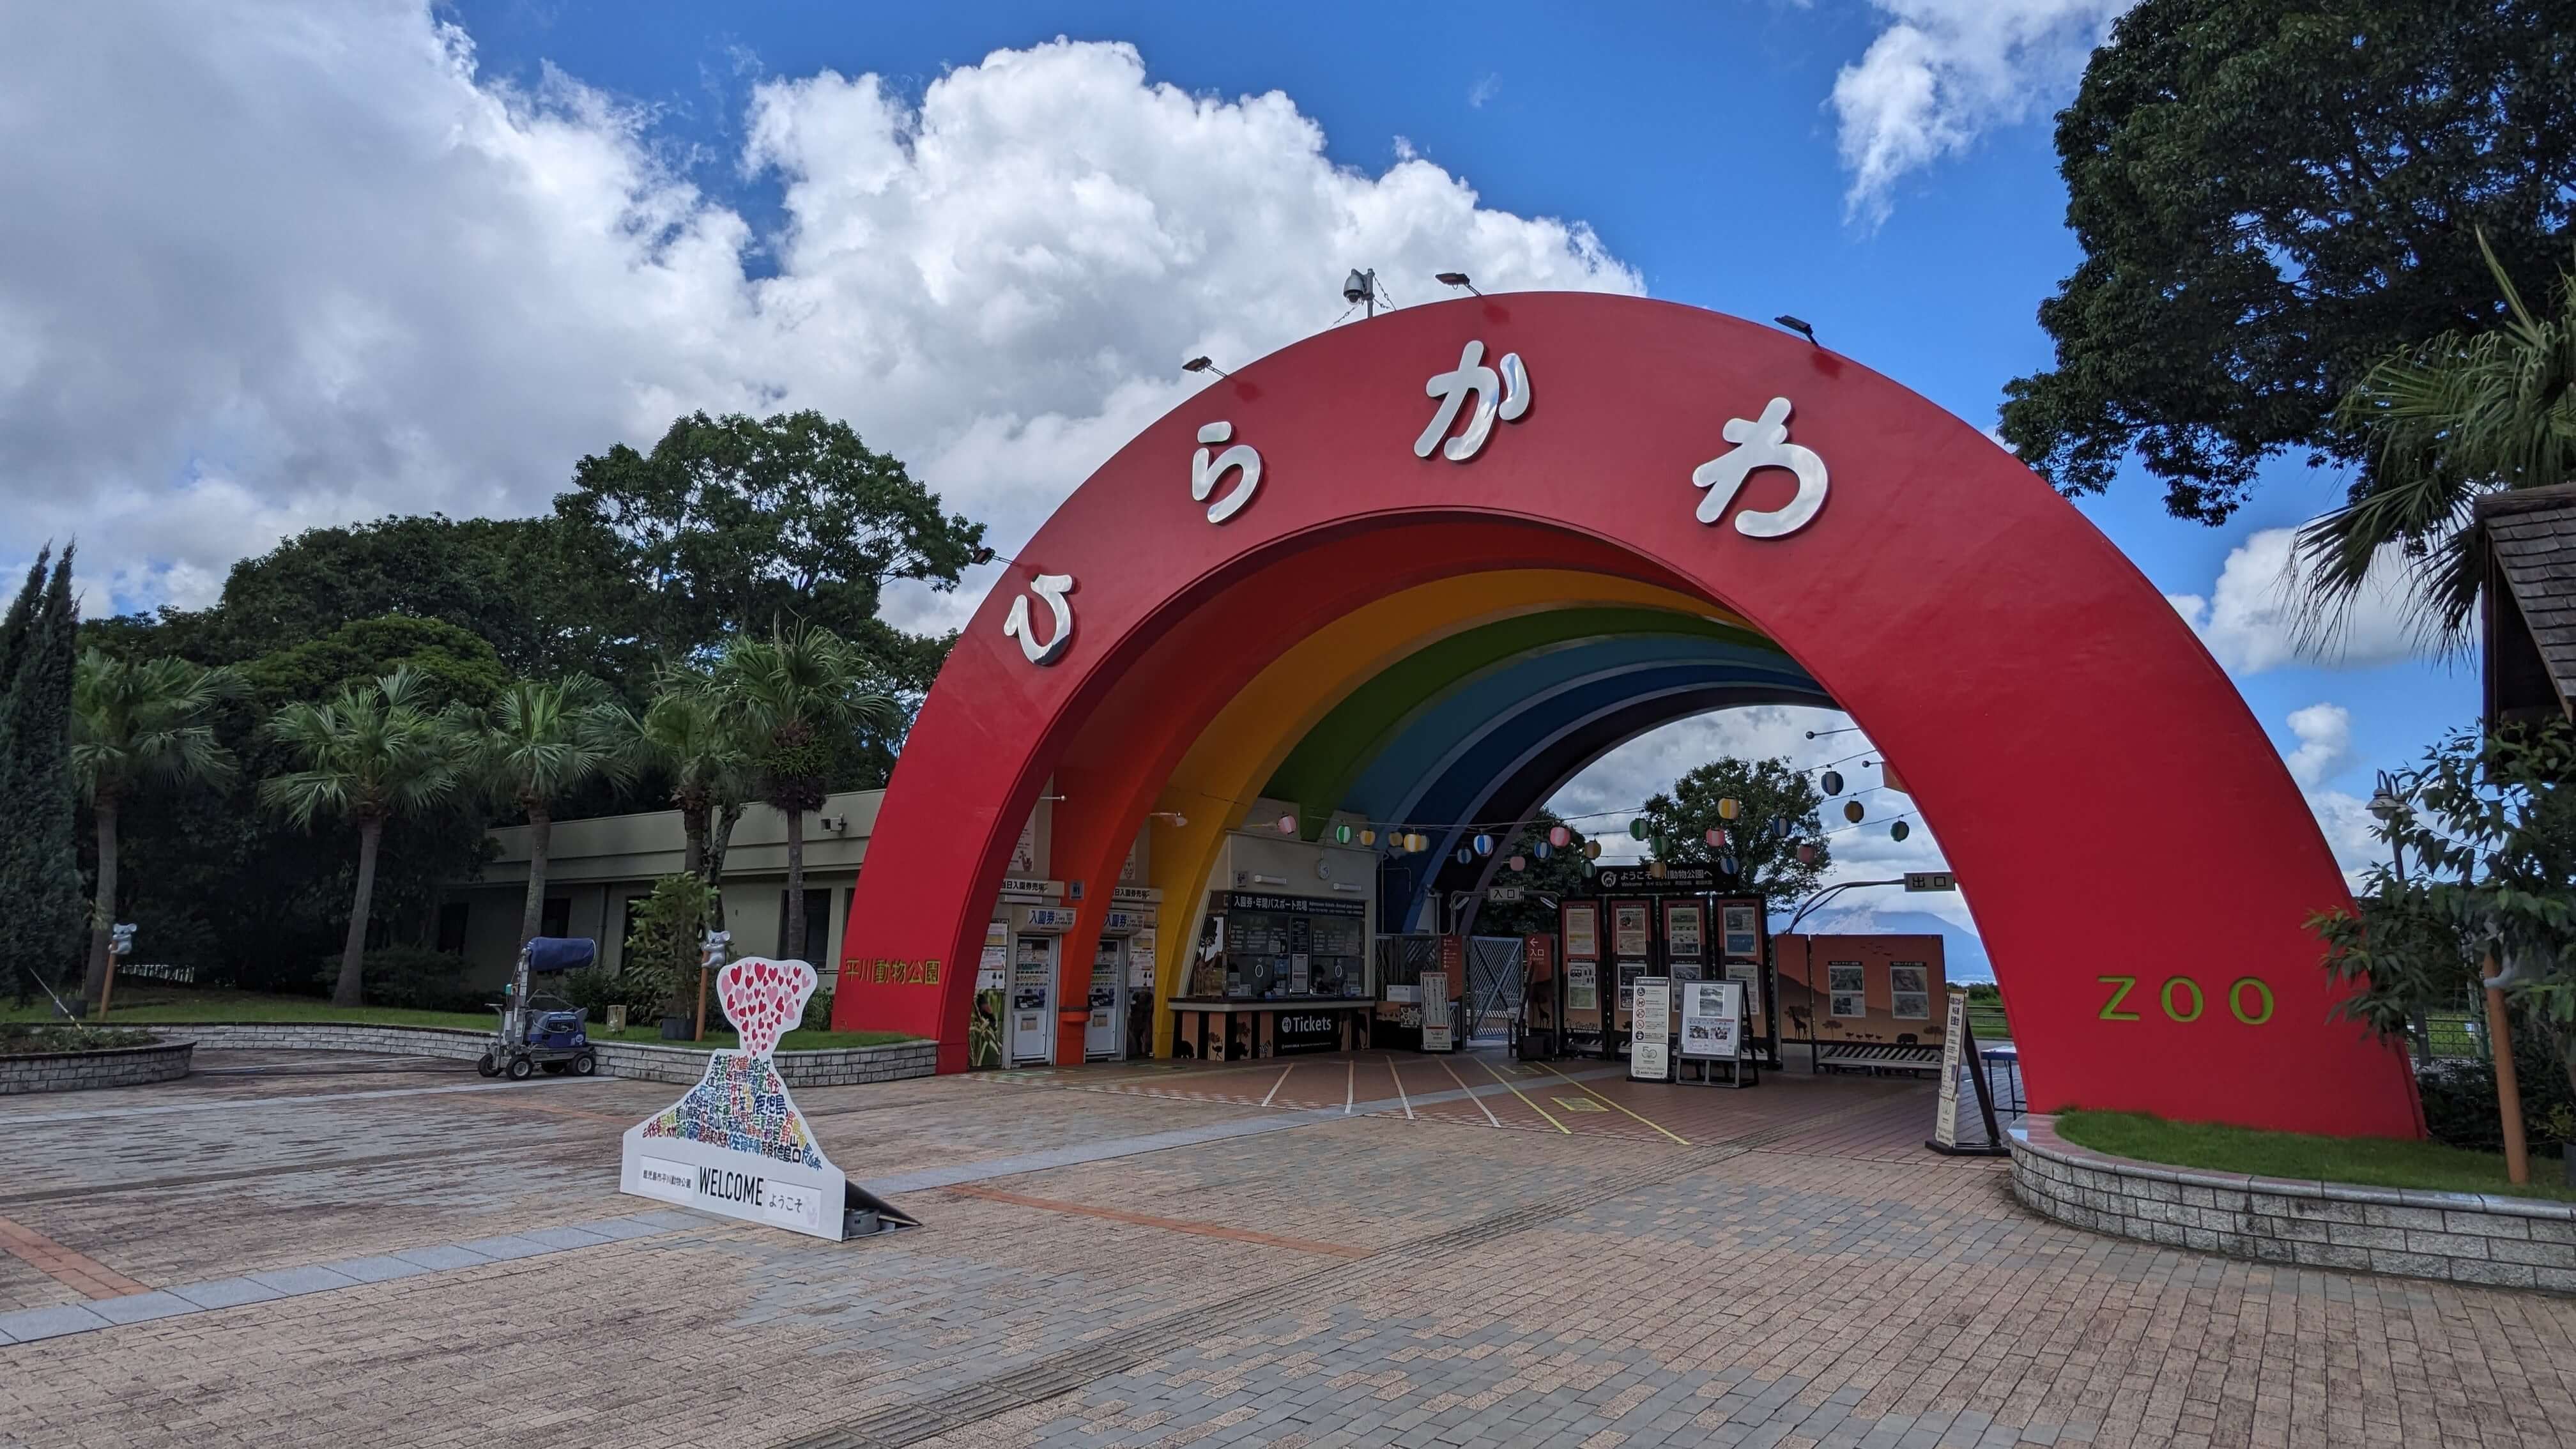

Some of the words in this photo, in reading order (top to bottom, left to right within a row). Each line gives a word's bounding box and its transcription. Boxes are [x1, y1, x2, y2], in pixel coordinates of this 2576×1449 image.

[1621, 870, 1713, 880] ようこそ川動物公園へ
[1912, 876, 1946, 887] 出口
[1494, 889, 1515, 898] 入口
[1029, 910, 1054, 924] 入園券
[845, 959, 940, 985] 平川動物公園
[1293, 1015, 1331, 1032] Tickets
[700, 1166, 764, 1206] WELCOME
[769, 1193, 802, 1213] ようこそ
